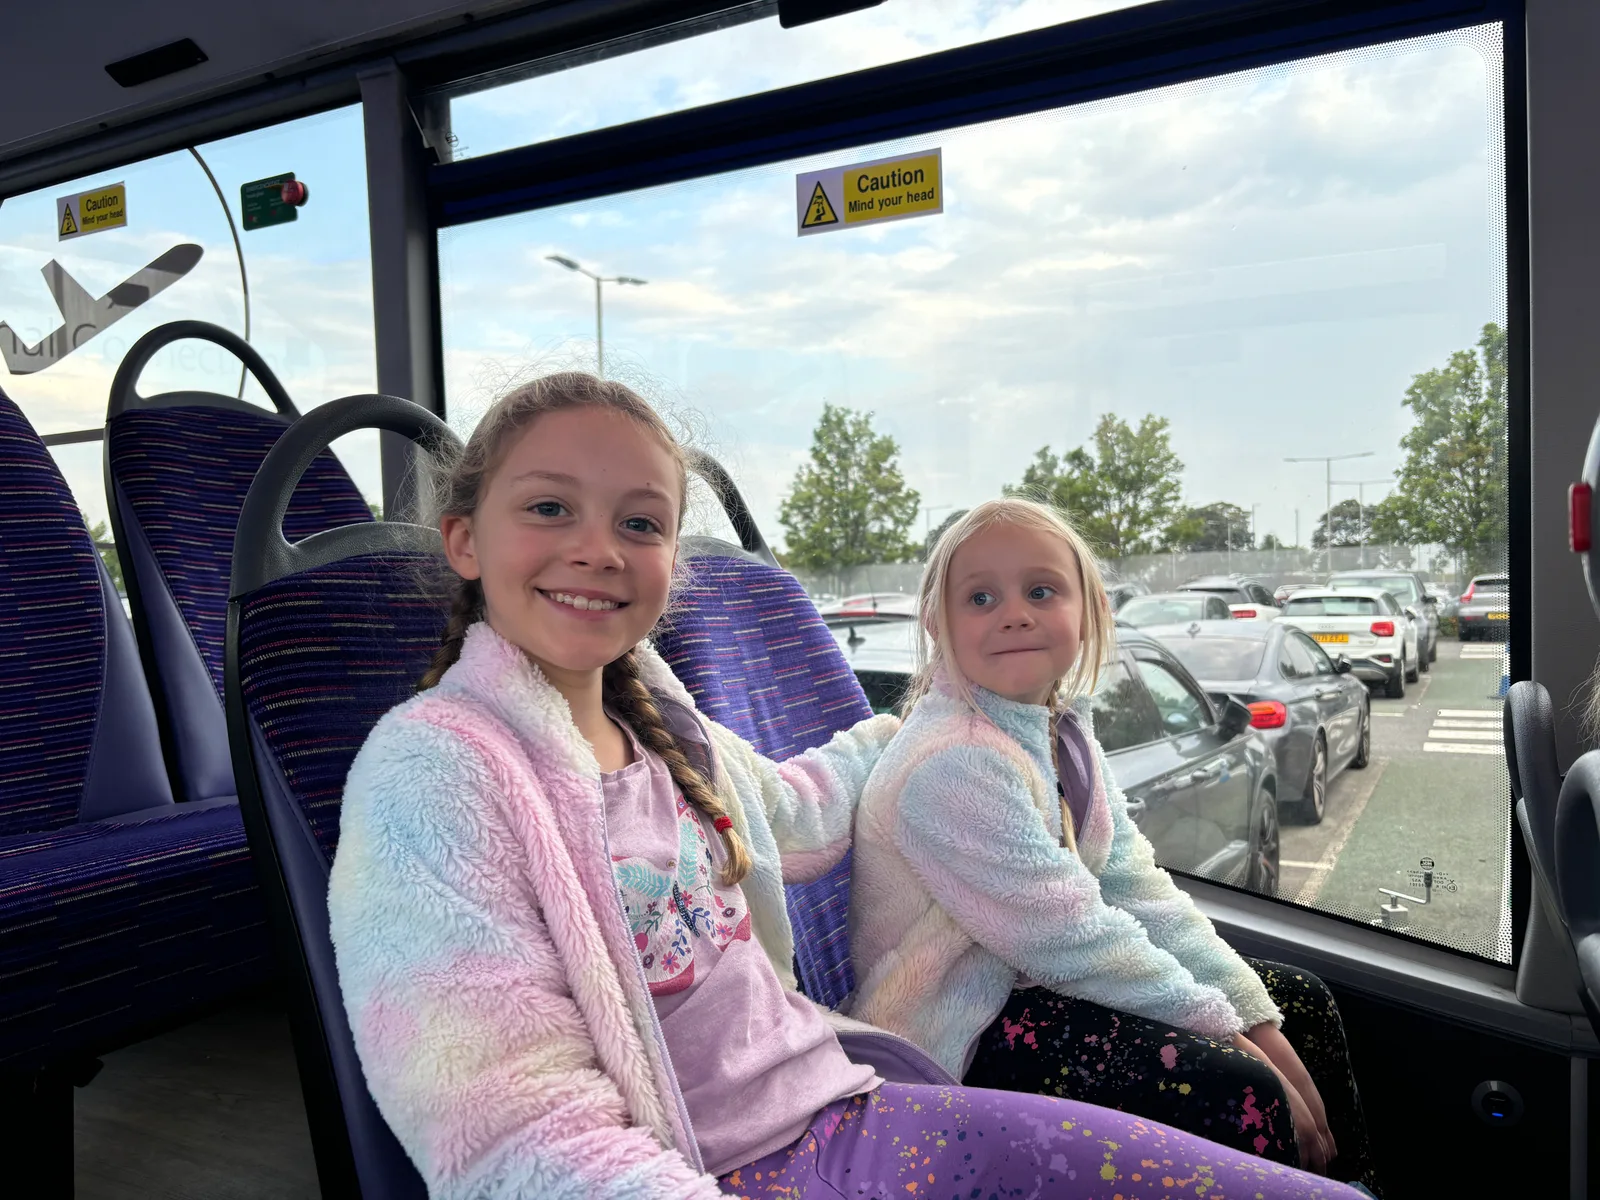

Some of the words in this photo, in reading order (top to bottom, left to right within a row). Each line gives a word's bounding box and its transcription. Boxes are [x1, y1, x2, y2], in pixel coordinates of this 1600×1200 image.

[857, 168, 925, 193] Caution
[86, 195, 118, 212] Caution
[848, 197, 874, 213] Mind
[878, 194, 903, 211] your
[906, 187, 935, 203] head
[82, 215, 95, 225] Mind
[96, 213, 108, 224] your
[109, 208, 124, 218] head
